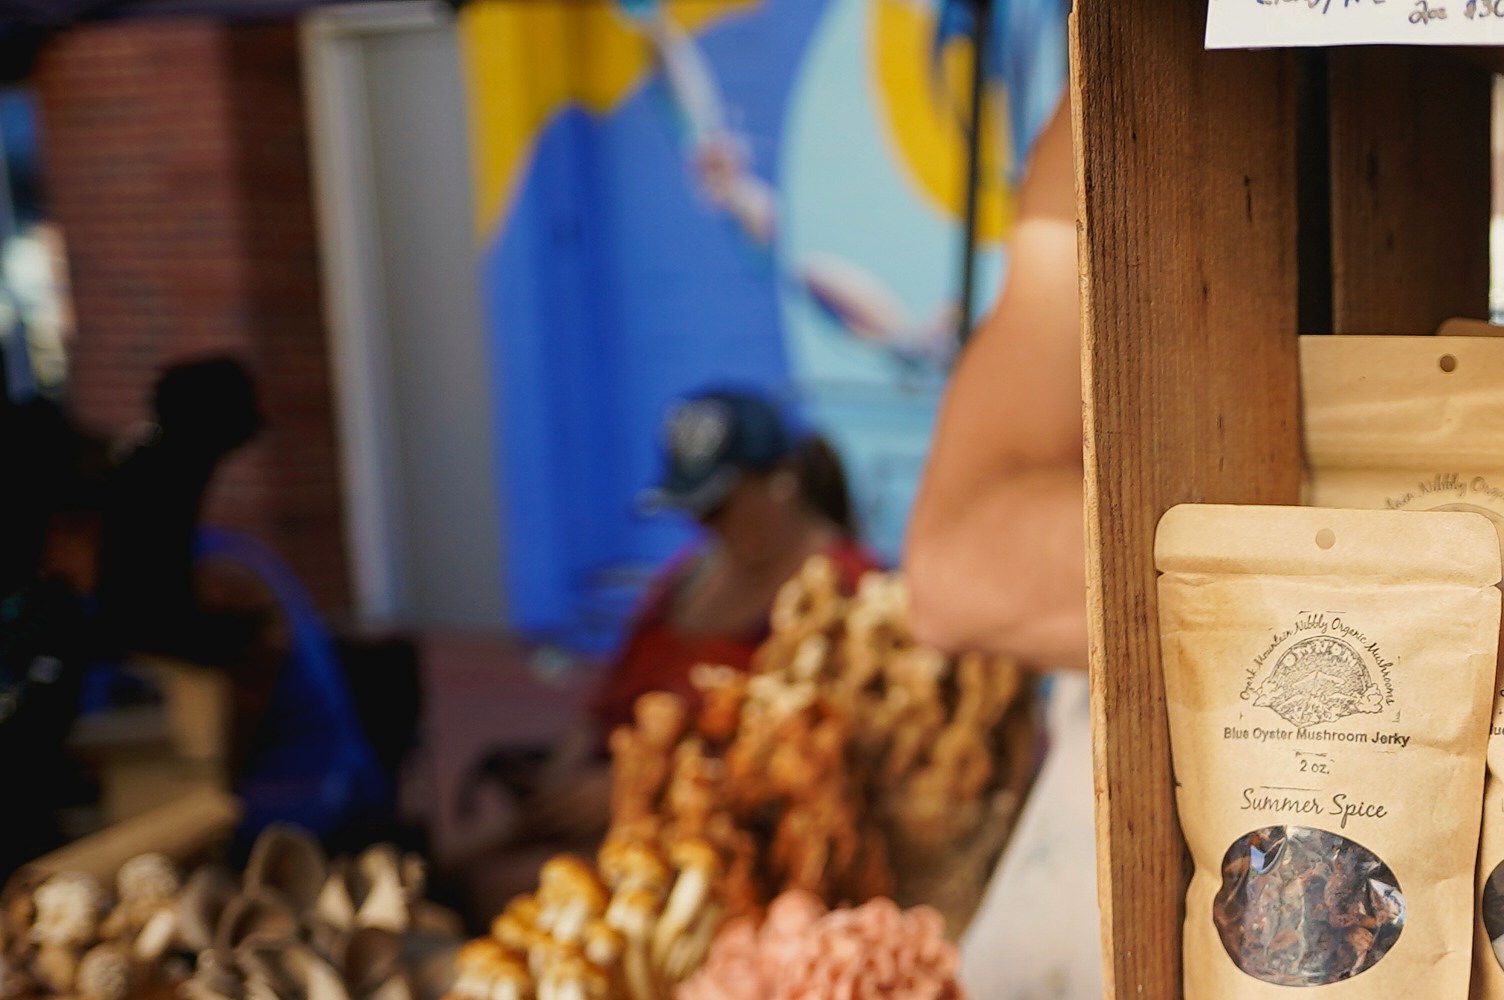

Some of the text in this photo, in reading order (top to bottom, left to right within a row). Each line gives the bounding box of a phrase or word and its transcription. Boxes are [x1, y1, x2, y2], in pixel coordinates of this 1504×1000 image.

[1254, 628, 1294, 670] Mountain
[1331, 617, 1368, 645] Organic
[1364, 642, 1397, 706] Mushrooms
[1223, 727, 1411, 748] Blue Oyster Mushroom Jerky
[1299, 759, 1331, 775] 2 oz.
[1240, 787, 1388, 829] Summer Spice
